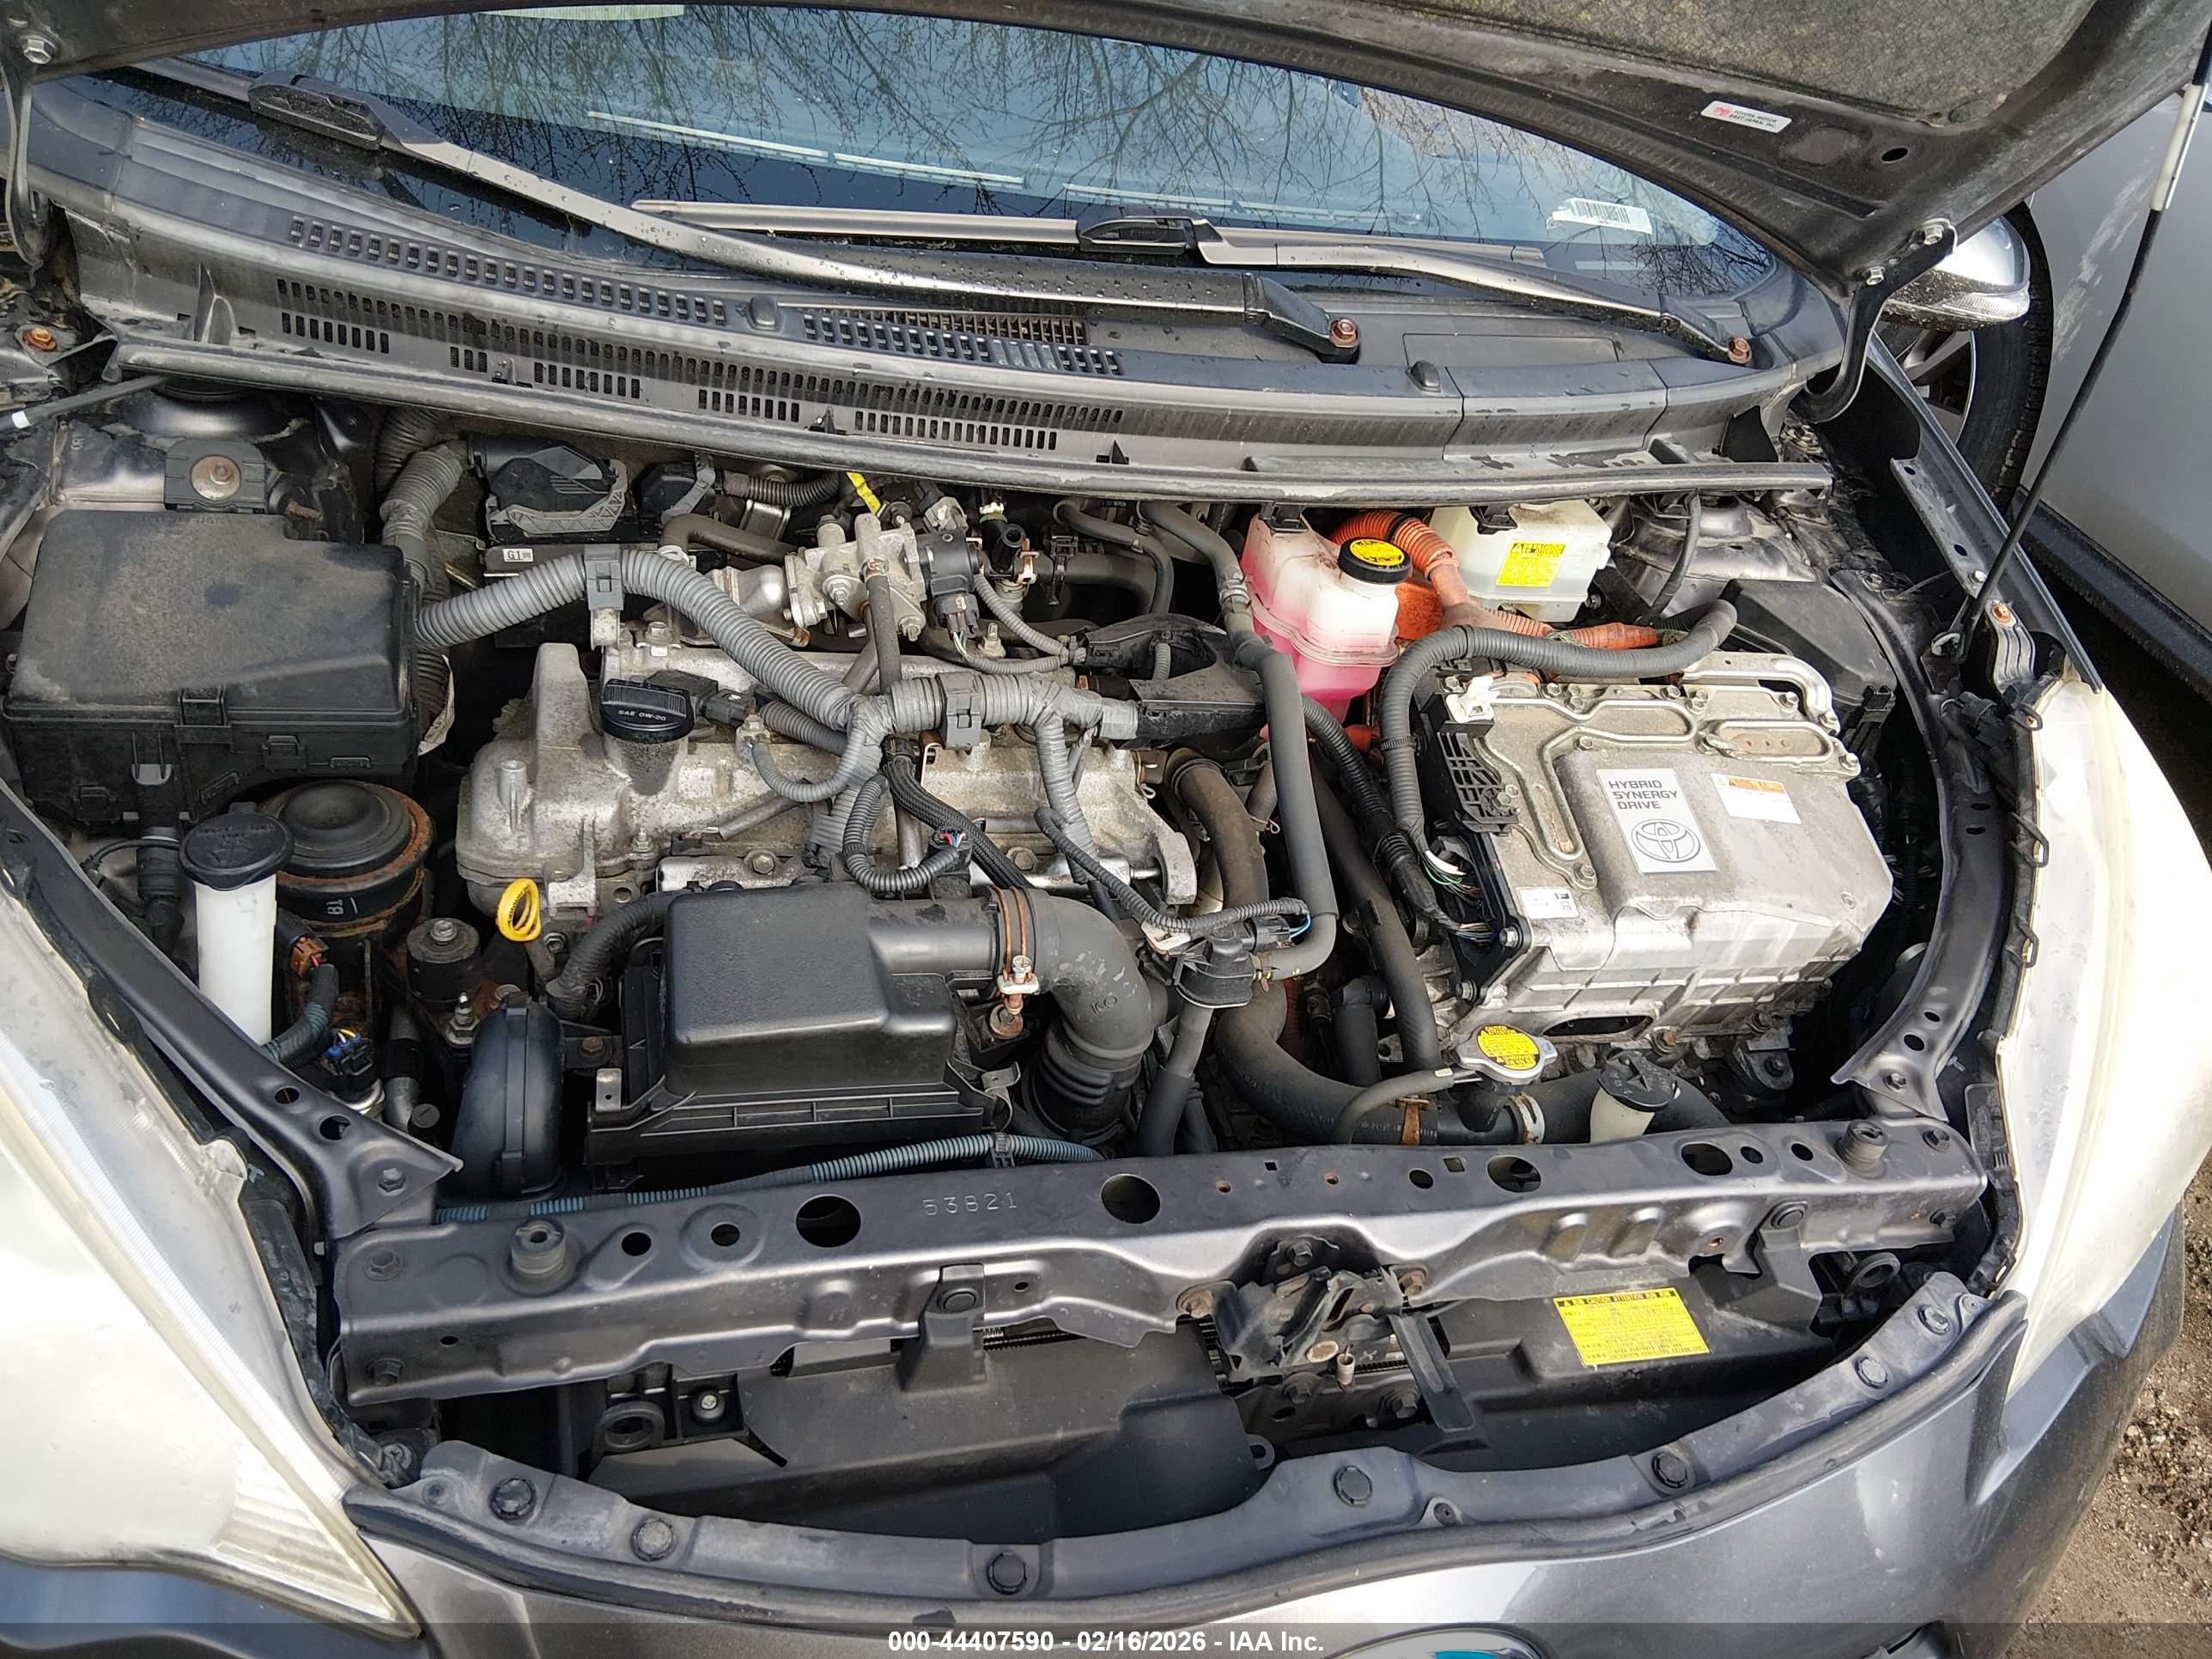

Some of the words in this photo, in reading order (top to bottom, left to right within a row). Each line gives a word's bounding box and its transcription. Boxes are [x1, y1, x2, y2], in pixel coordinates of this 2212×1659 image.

[1608, 780, 1662, 789] HYBRID
[1613, 790, 1678, 799] SYNERGY
[1617, 800, 1662, 810] DRIVE
[922, 1192, 1017, 1216] 53821
